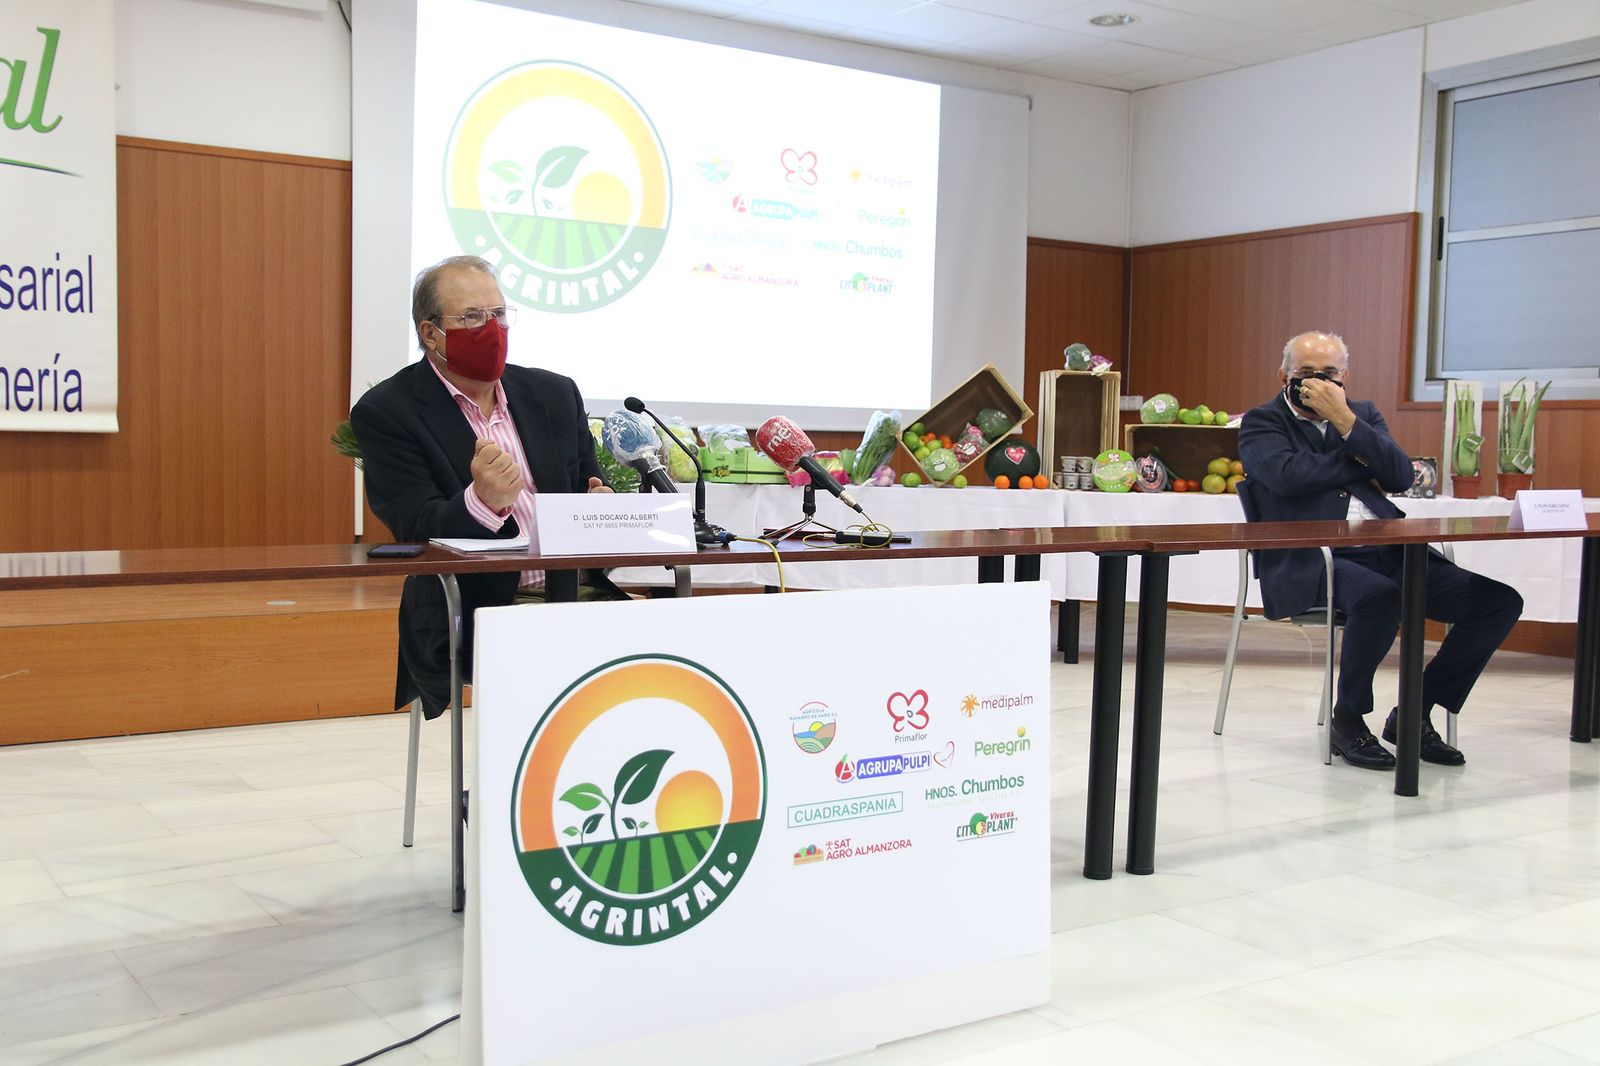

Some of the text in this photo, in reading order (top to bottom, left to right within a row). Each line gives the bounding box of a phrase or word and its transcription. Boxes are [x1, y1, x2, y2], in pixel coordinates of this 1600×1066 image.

[846, 240, 904, 259] Chumbos
[767, 427, 791, 452] rne
[619, 521, 655, 529] PRIMAFLOR
[630, 513, 659, 521] ALBERTI
[981, 693, 1034, 711] medipalm
[894, 732, 928, 743] Primaflor
[974, 733, 1031, 757] Peregrin
[925, 774, 1025, 800] HNOS. Chumbos
[794, 798, 897, 823] CUADRASPANIA
[990, 811, 1014, 820] Viveros
[826, 838, 913, 861] AGRO ALMANZORA
[834, 838, 851, 850] SAT
[554, 865, 734, 936] AGRINTAL
